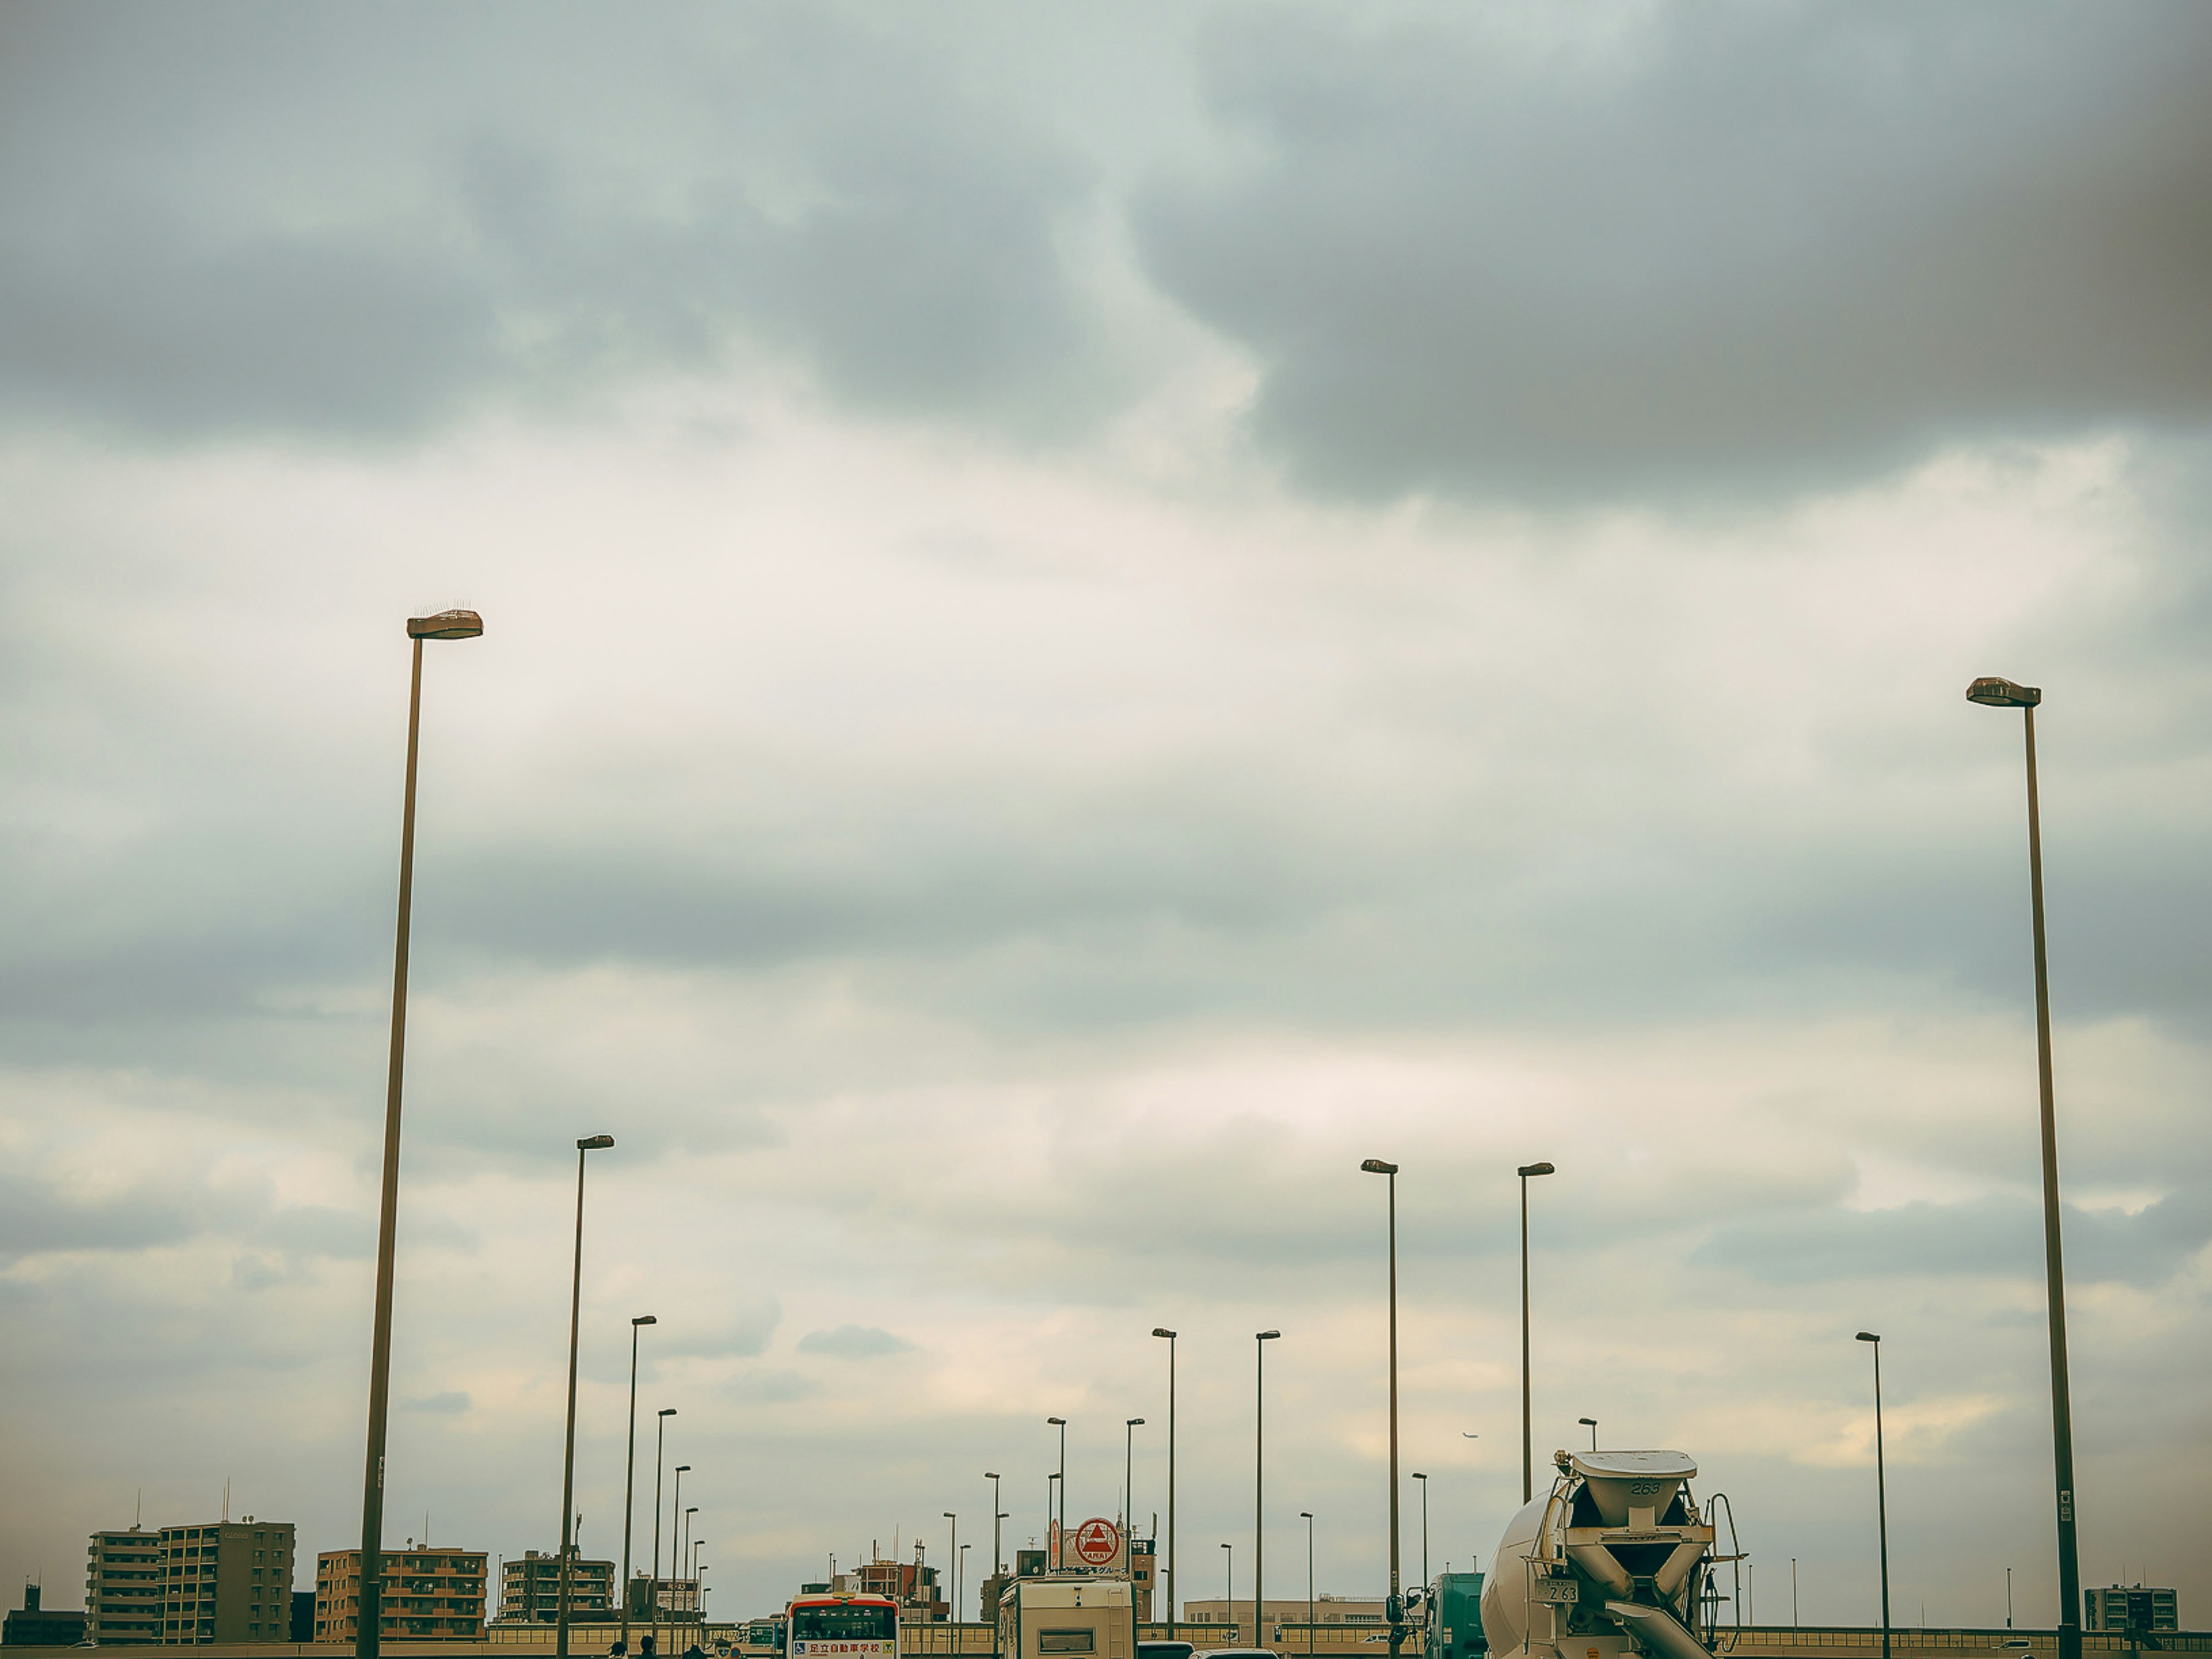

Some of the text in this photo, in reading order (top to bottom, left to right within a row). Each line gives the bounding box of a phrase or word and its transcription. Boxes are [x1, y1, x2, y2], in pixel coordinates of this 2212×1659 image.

[1631, 1482, 1660, 1495] 263
[809, 1643, 880, 1653] 足立自動車学校
